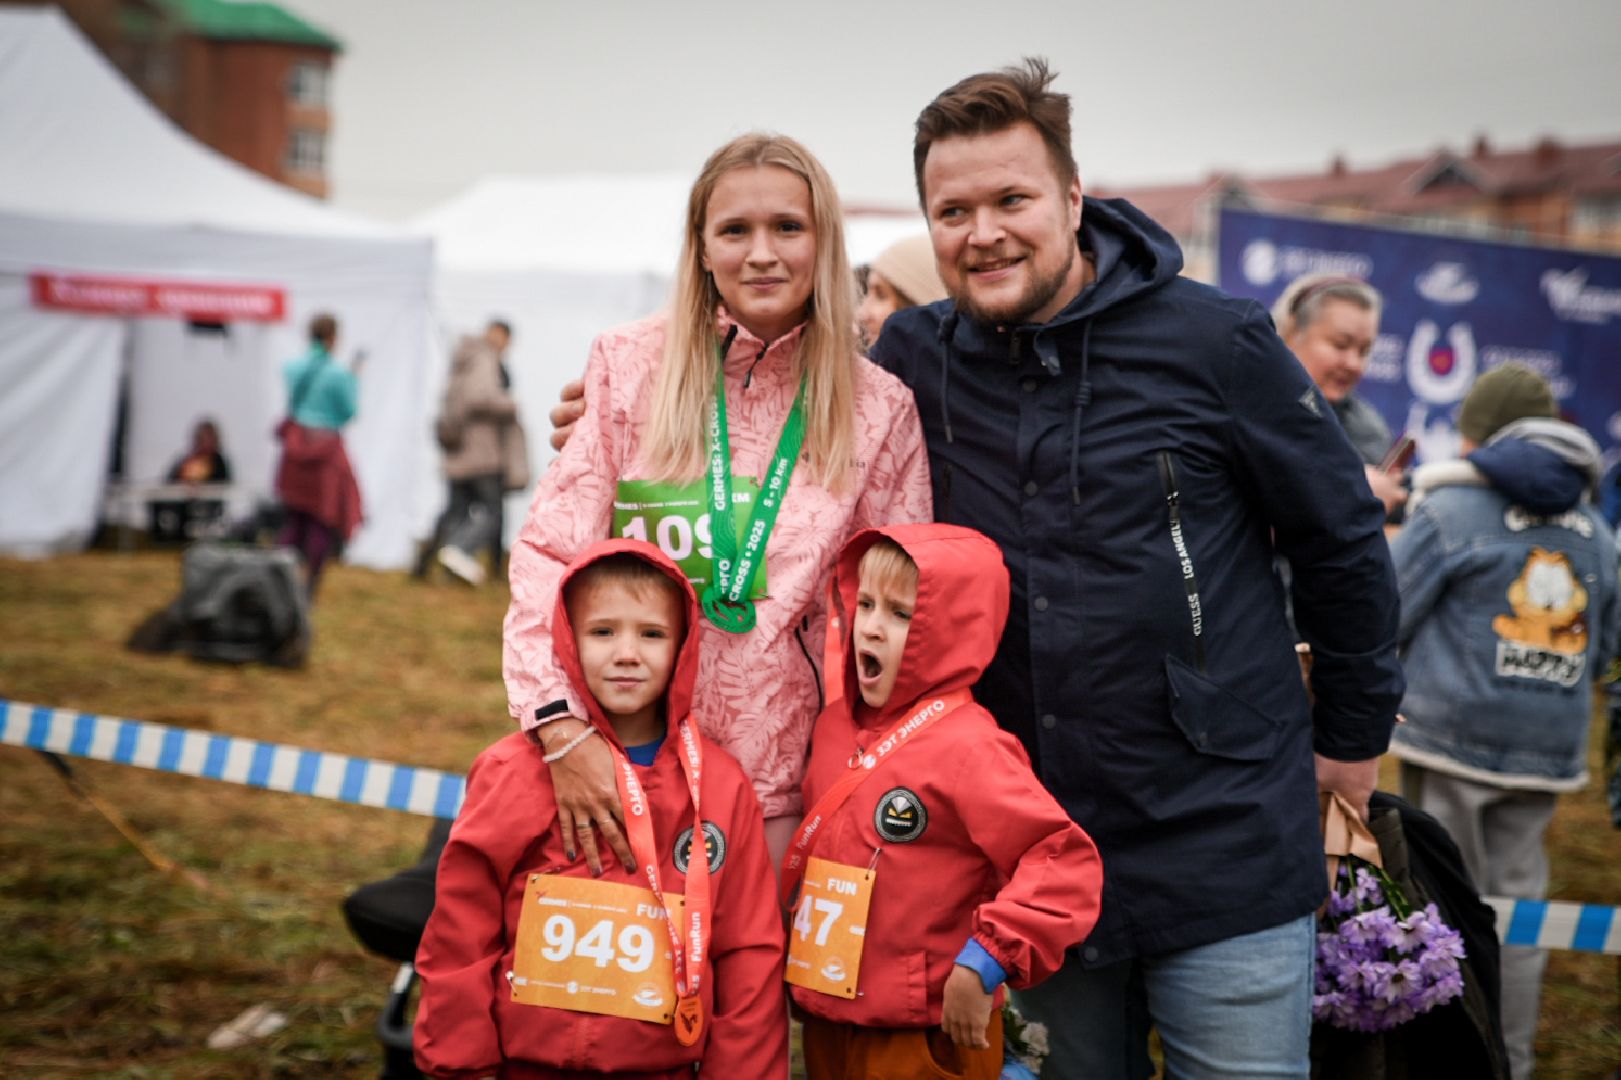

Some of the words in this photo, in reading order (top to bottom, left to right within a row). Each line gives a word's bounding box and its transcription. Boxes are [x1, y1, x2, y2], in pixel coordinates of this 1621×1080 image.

[769, 477, 783, 491] 10
[745, 519, 767, 552] 2025
[1181, 558, 1195, 580] LOS
[1187, 592, 1202, 637] GUESS
[875, 732, 897, 758] ЗЭТ
[896, 699, 946, 740] ЭНЕРГО
[797, 814, 823, 851] FunRun
[826, 878, 858, 897] FUN
[541, 914, 655, 973] 949
[690, 911, 703, 963] FunRun
